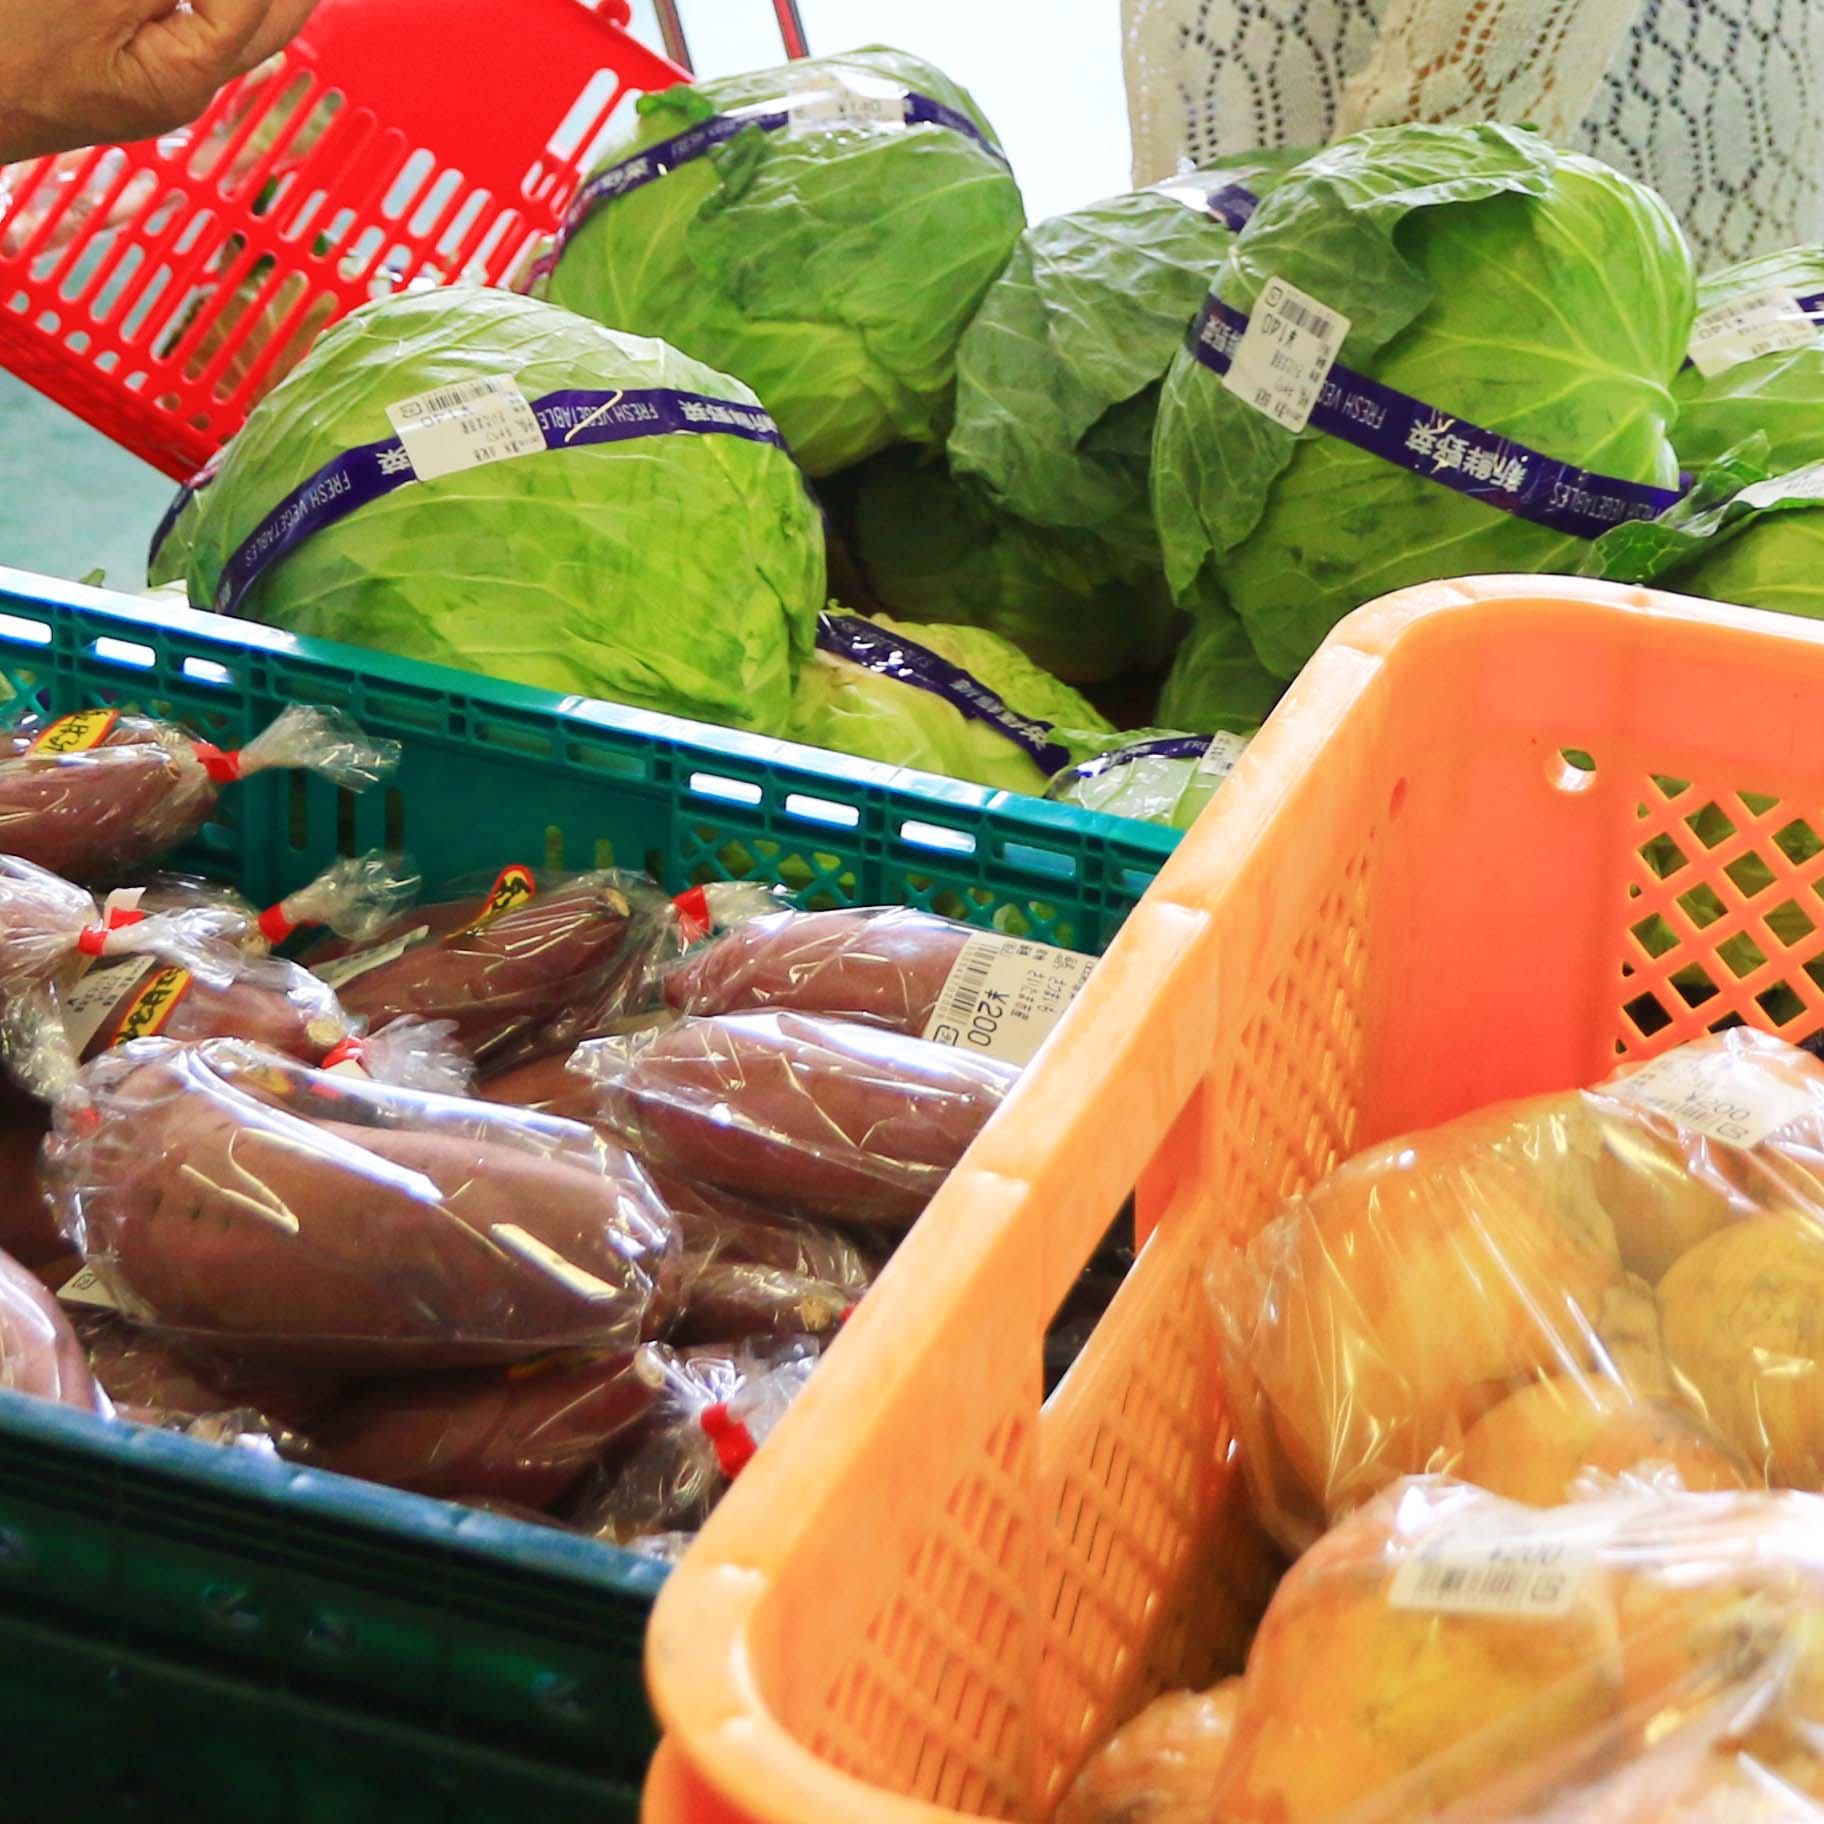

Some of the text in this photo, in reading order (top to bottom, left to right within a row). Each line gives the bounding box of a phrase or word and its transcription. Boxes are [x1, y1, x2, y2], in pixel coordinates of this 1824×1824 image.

[616, 403, 660, 423] FRESH
[1343, 392, 1388, 429] FRESH
[1405, 419, 1527, 493] 新鮮野菜
[245, 470, 351, 566] FRESH VEGETABLES
[967, 989, 1010, 1047] ¥200
